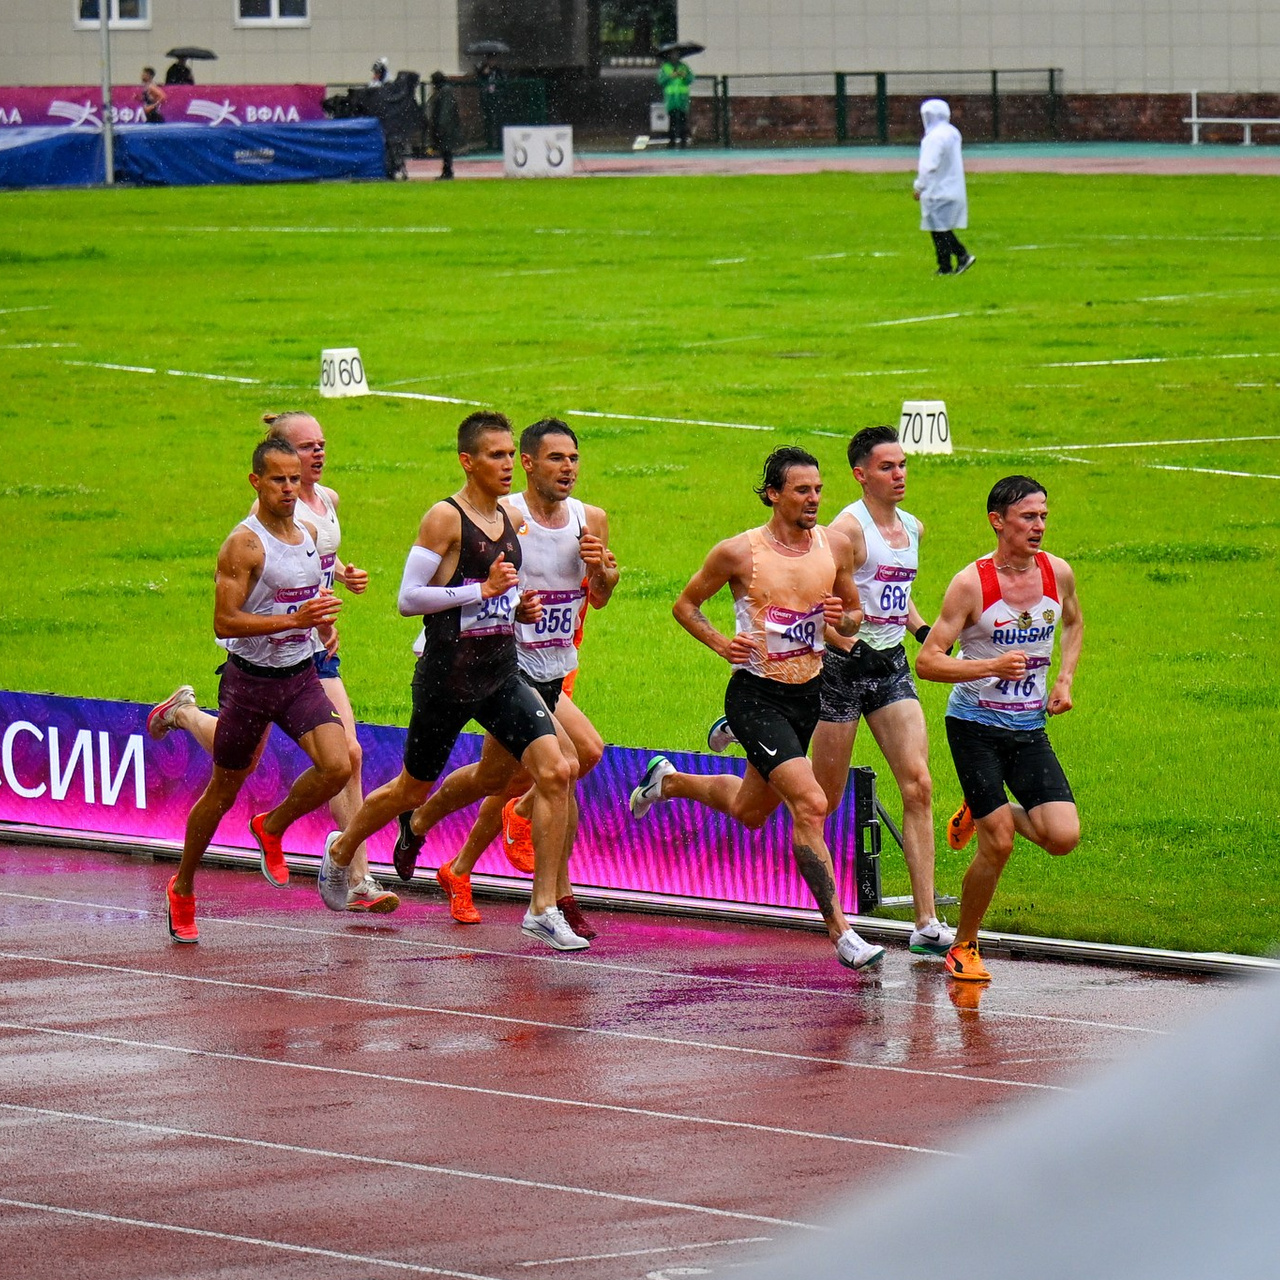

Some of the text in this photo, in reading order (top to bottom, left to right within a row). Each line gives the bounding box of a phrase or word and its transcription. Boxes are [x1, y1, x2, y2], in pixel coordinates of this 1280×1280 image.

[246, 105, 300, 122] ВФЛА
[321, 359, 335, 387] 60
[339, 357, 363, 386] 60
[902, 413, 923, 444] 70
[926, 411, 948, 444] 70
[535, 608, 572, 634] 658
[991, 625, 1054, 645] RUSSIA
[0, 720, 147, 811] СИИ
